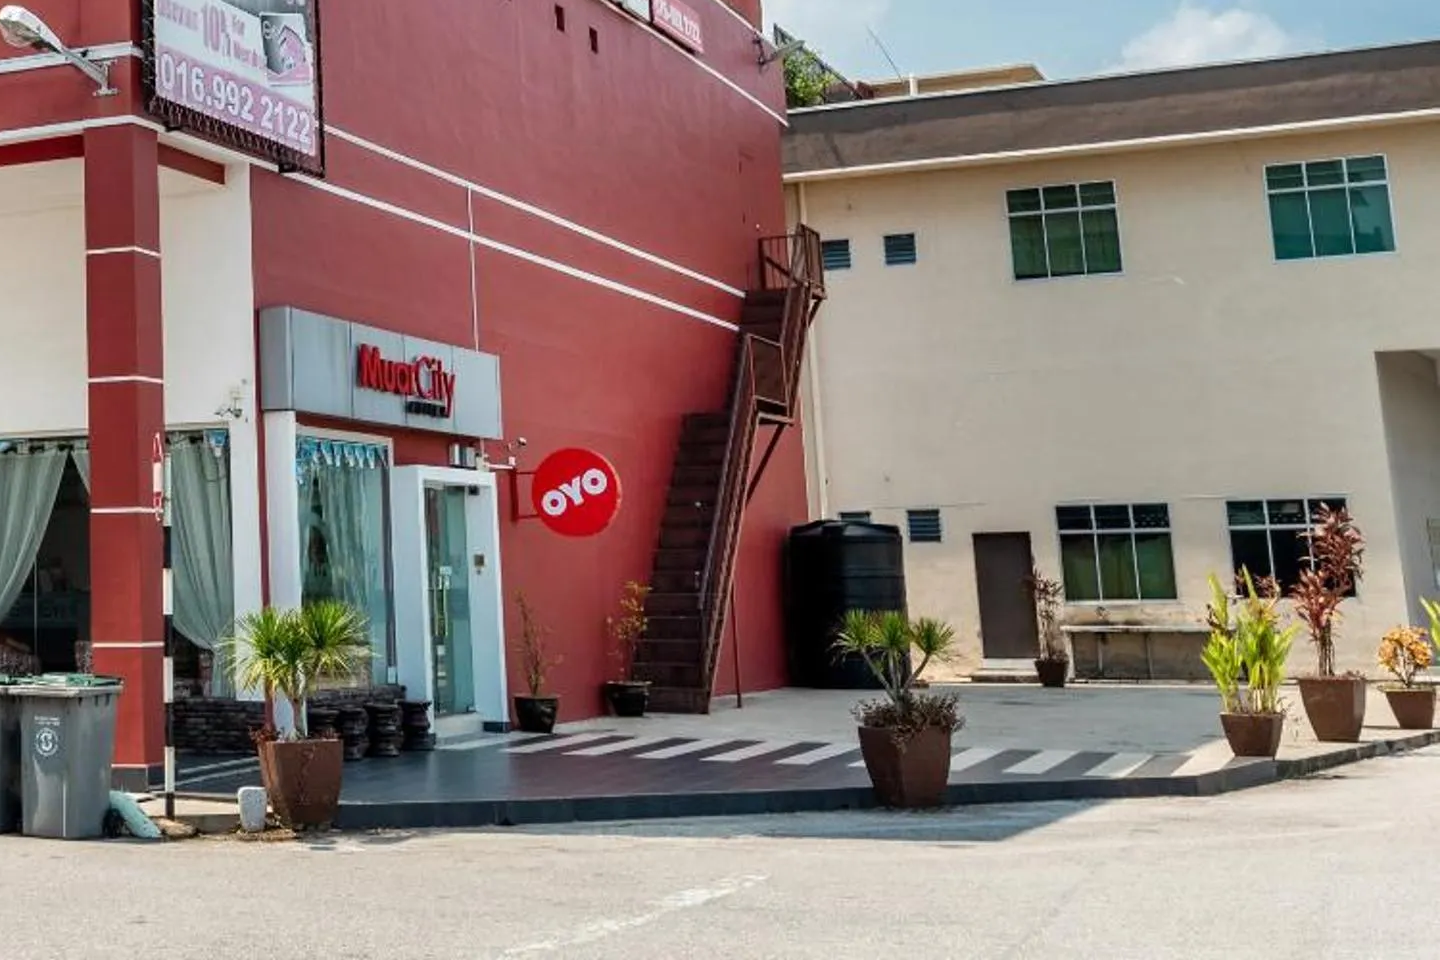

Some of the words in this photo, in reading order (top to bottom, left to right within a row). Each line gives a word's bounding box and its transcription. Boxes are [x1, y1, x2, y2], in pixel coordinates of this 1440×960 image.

[161, 53, 254, 121] 016.992
[260, 95, 310, 143] 2122
[541, 468, 607, 516] OYO
